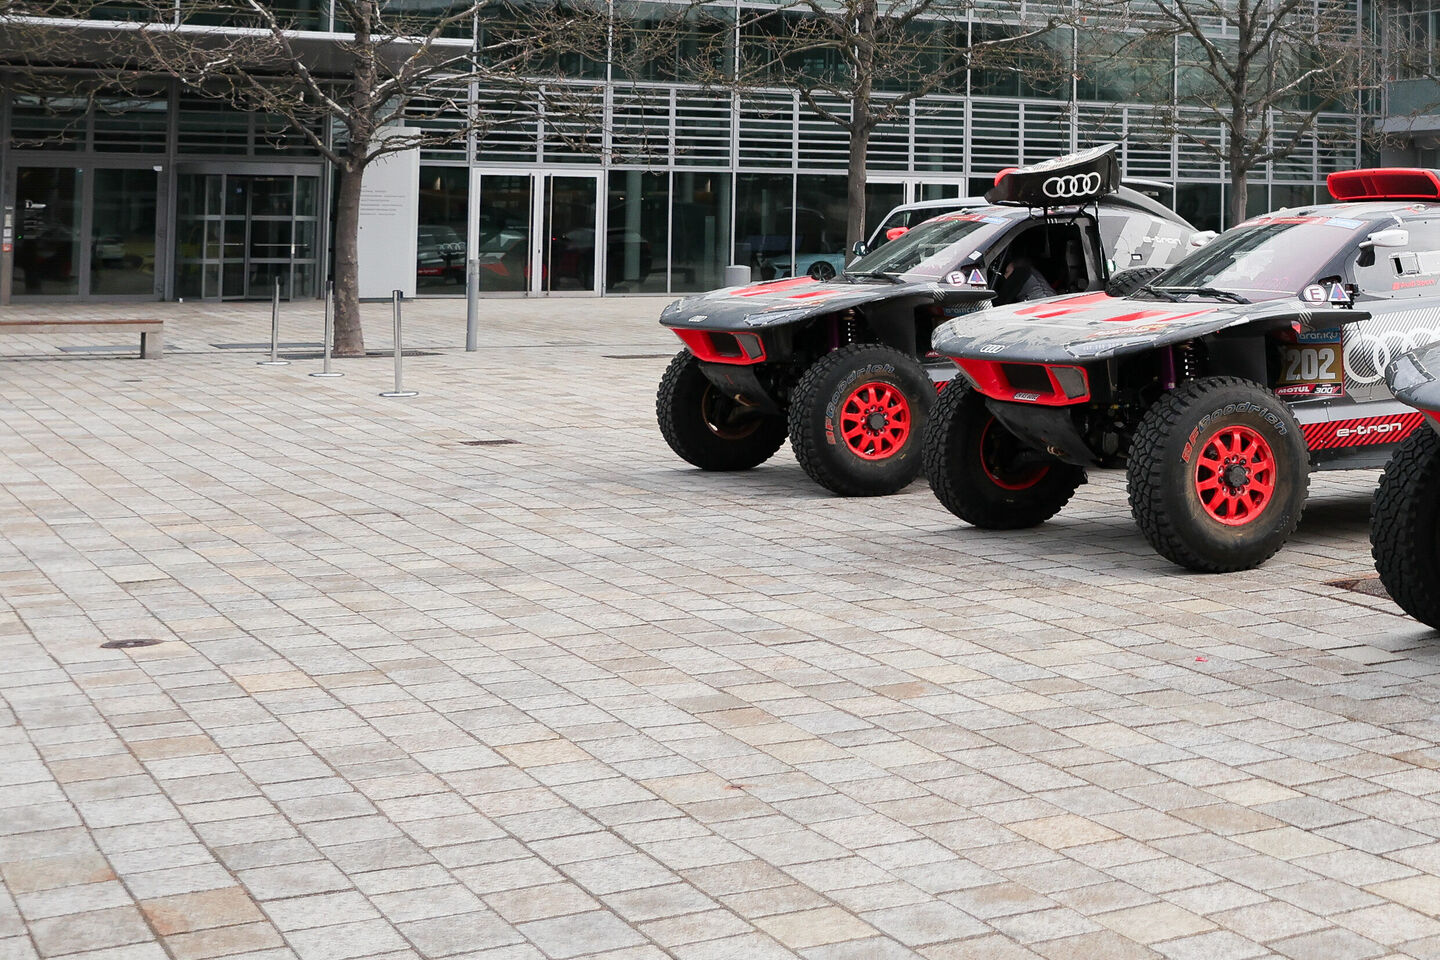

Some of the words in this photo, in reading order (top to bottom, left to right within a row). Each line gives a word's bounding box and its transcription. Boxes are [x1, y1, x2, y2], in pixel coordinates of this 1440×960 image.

[1143, 234, 1182, 245] e-tron
[951, 273, 962, 284] E
[1309, 288, 1322, 301] E
[1285, 348, 1336, 381] 202
[1277, 386, 1311, 394] MOTUL
[1336, 422, 1402, 437] e-tron
